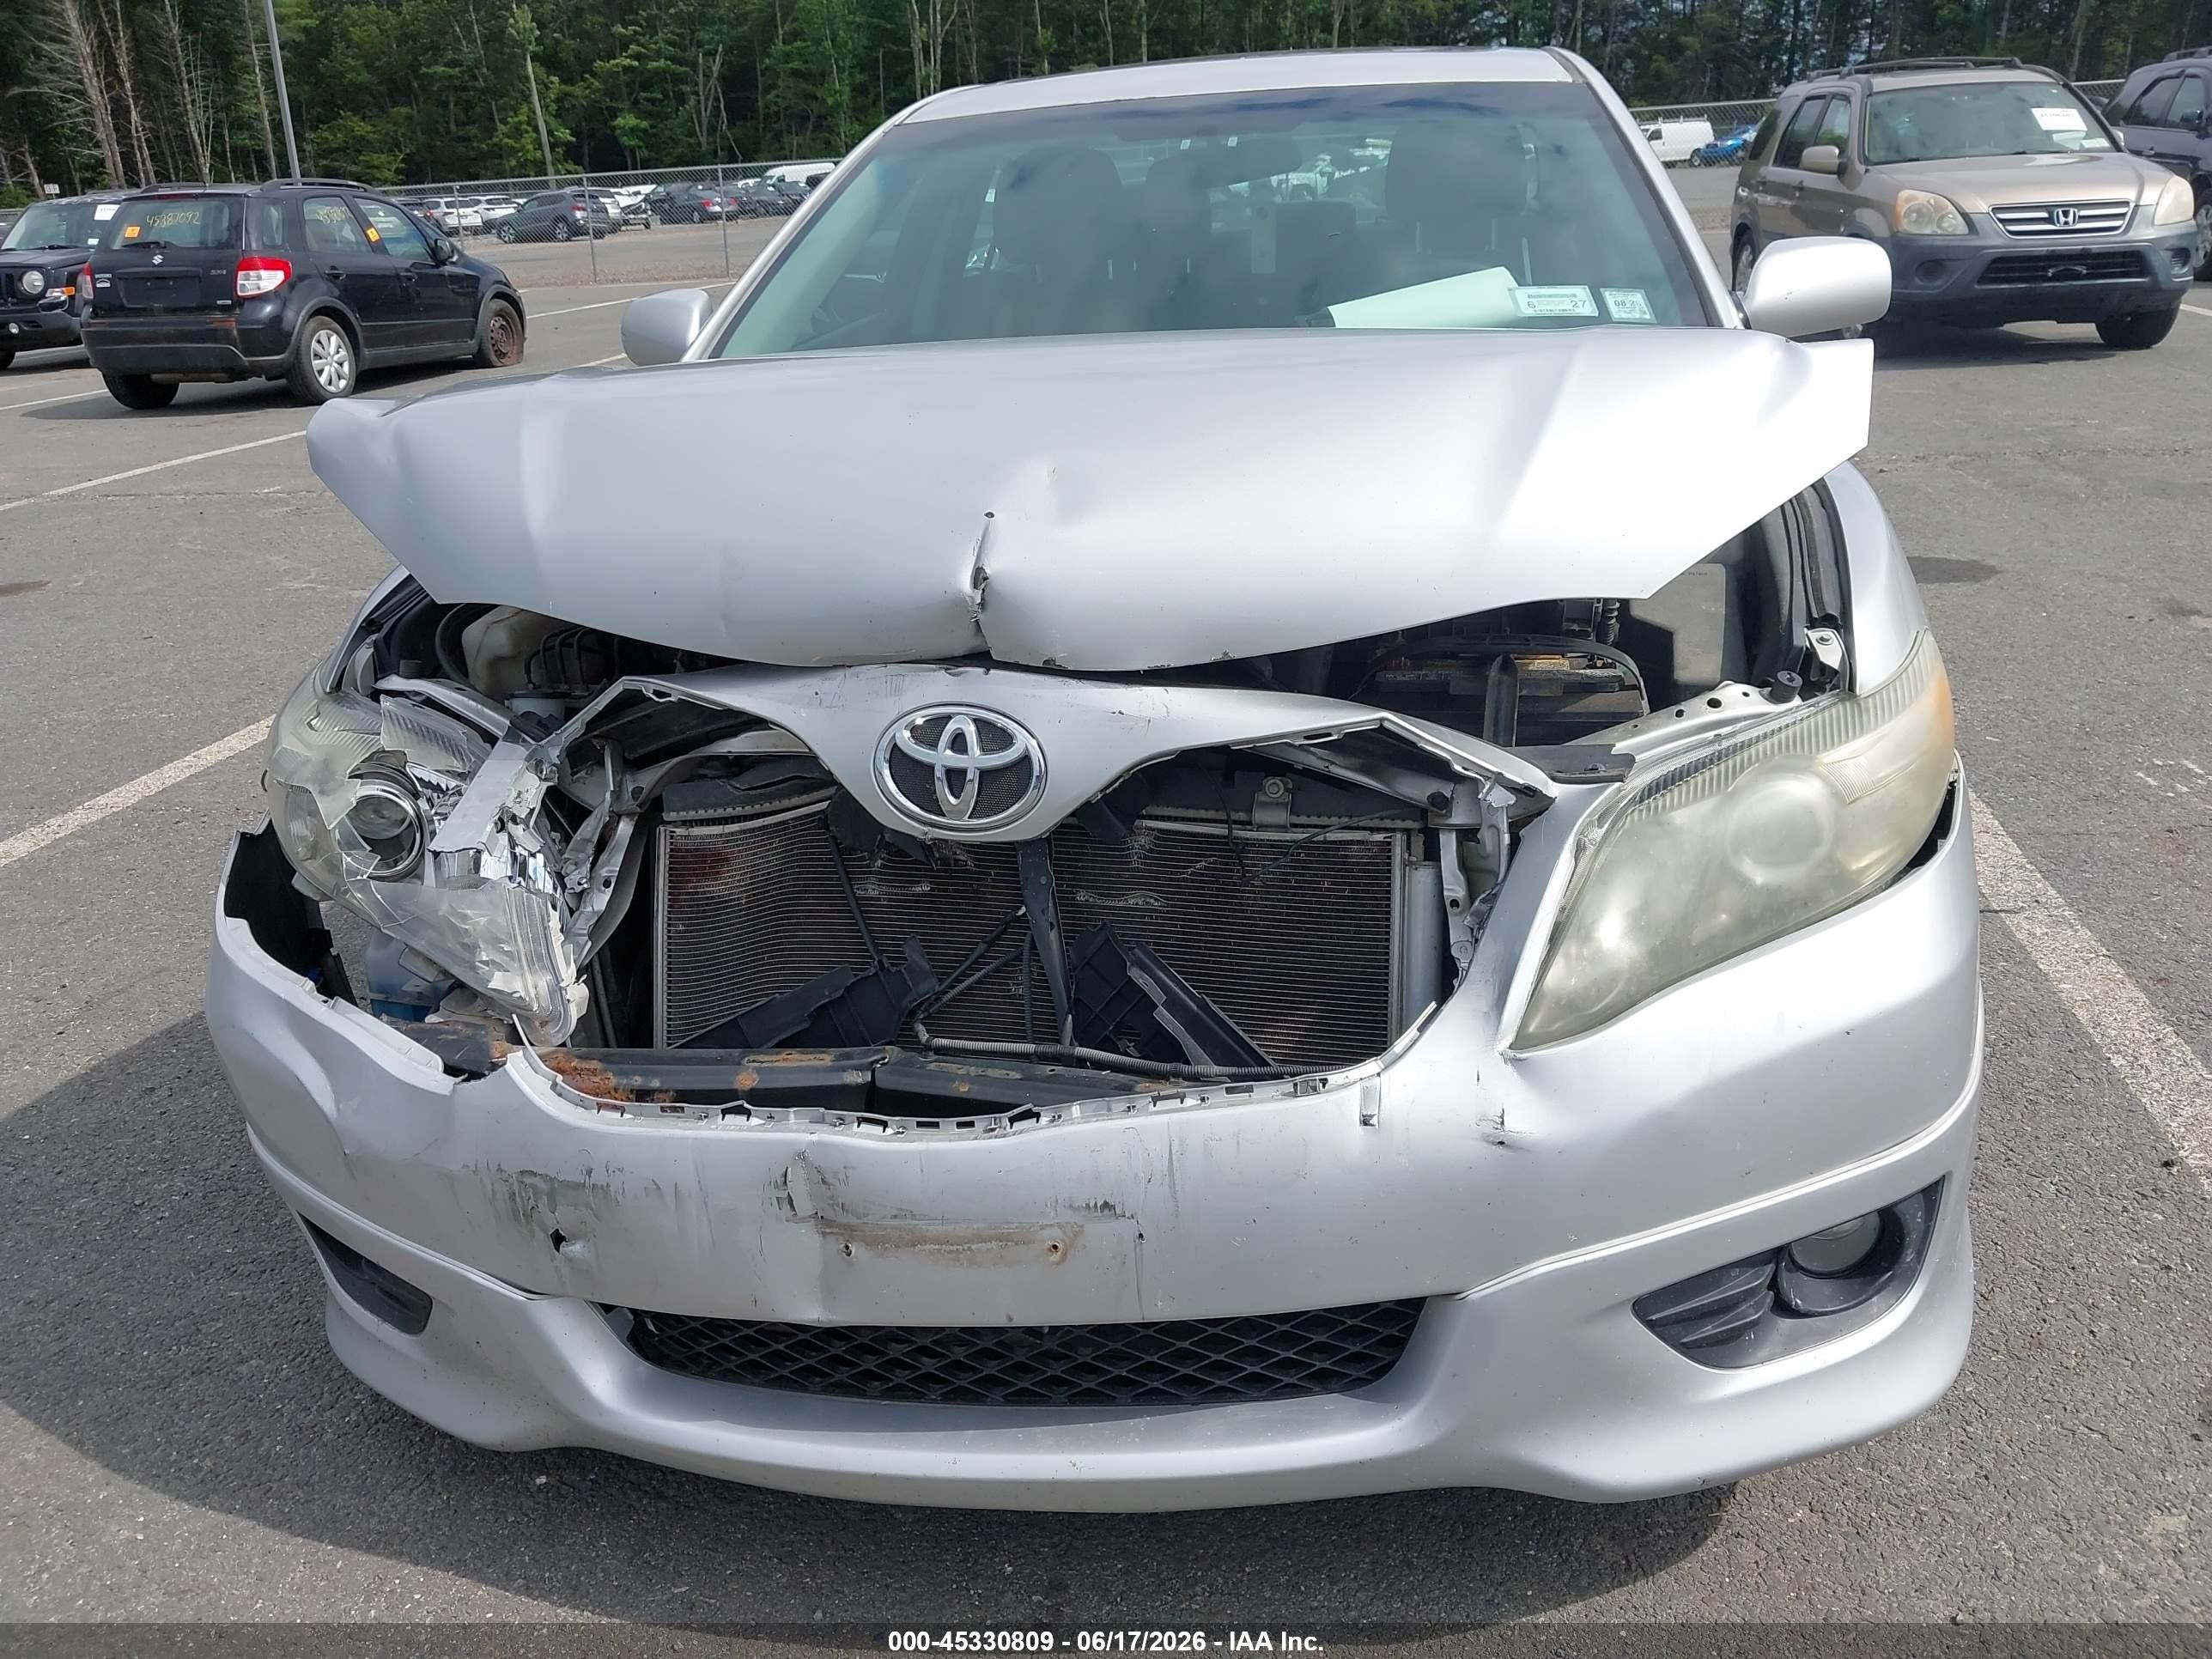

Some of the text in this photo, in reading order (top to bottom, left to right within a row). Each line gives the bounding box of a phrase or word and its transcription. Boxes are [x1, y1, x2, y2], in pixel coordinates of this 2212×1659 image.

[146, 211, 200, 227] 45387092
[1527, 300, 1587, 309] 6 27
